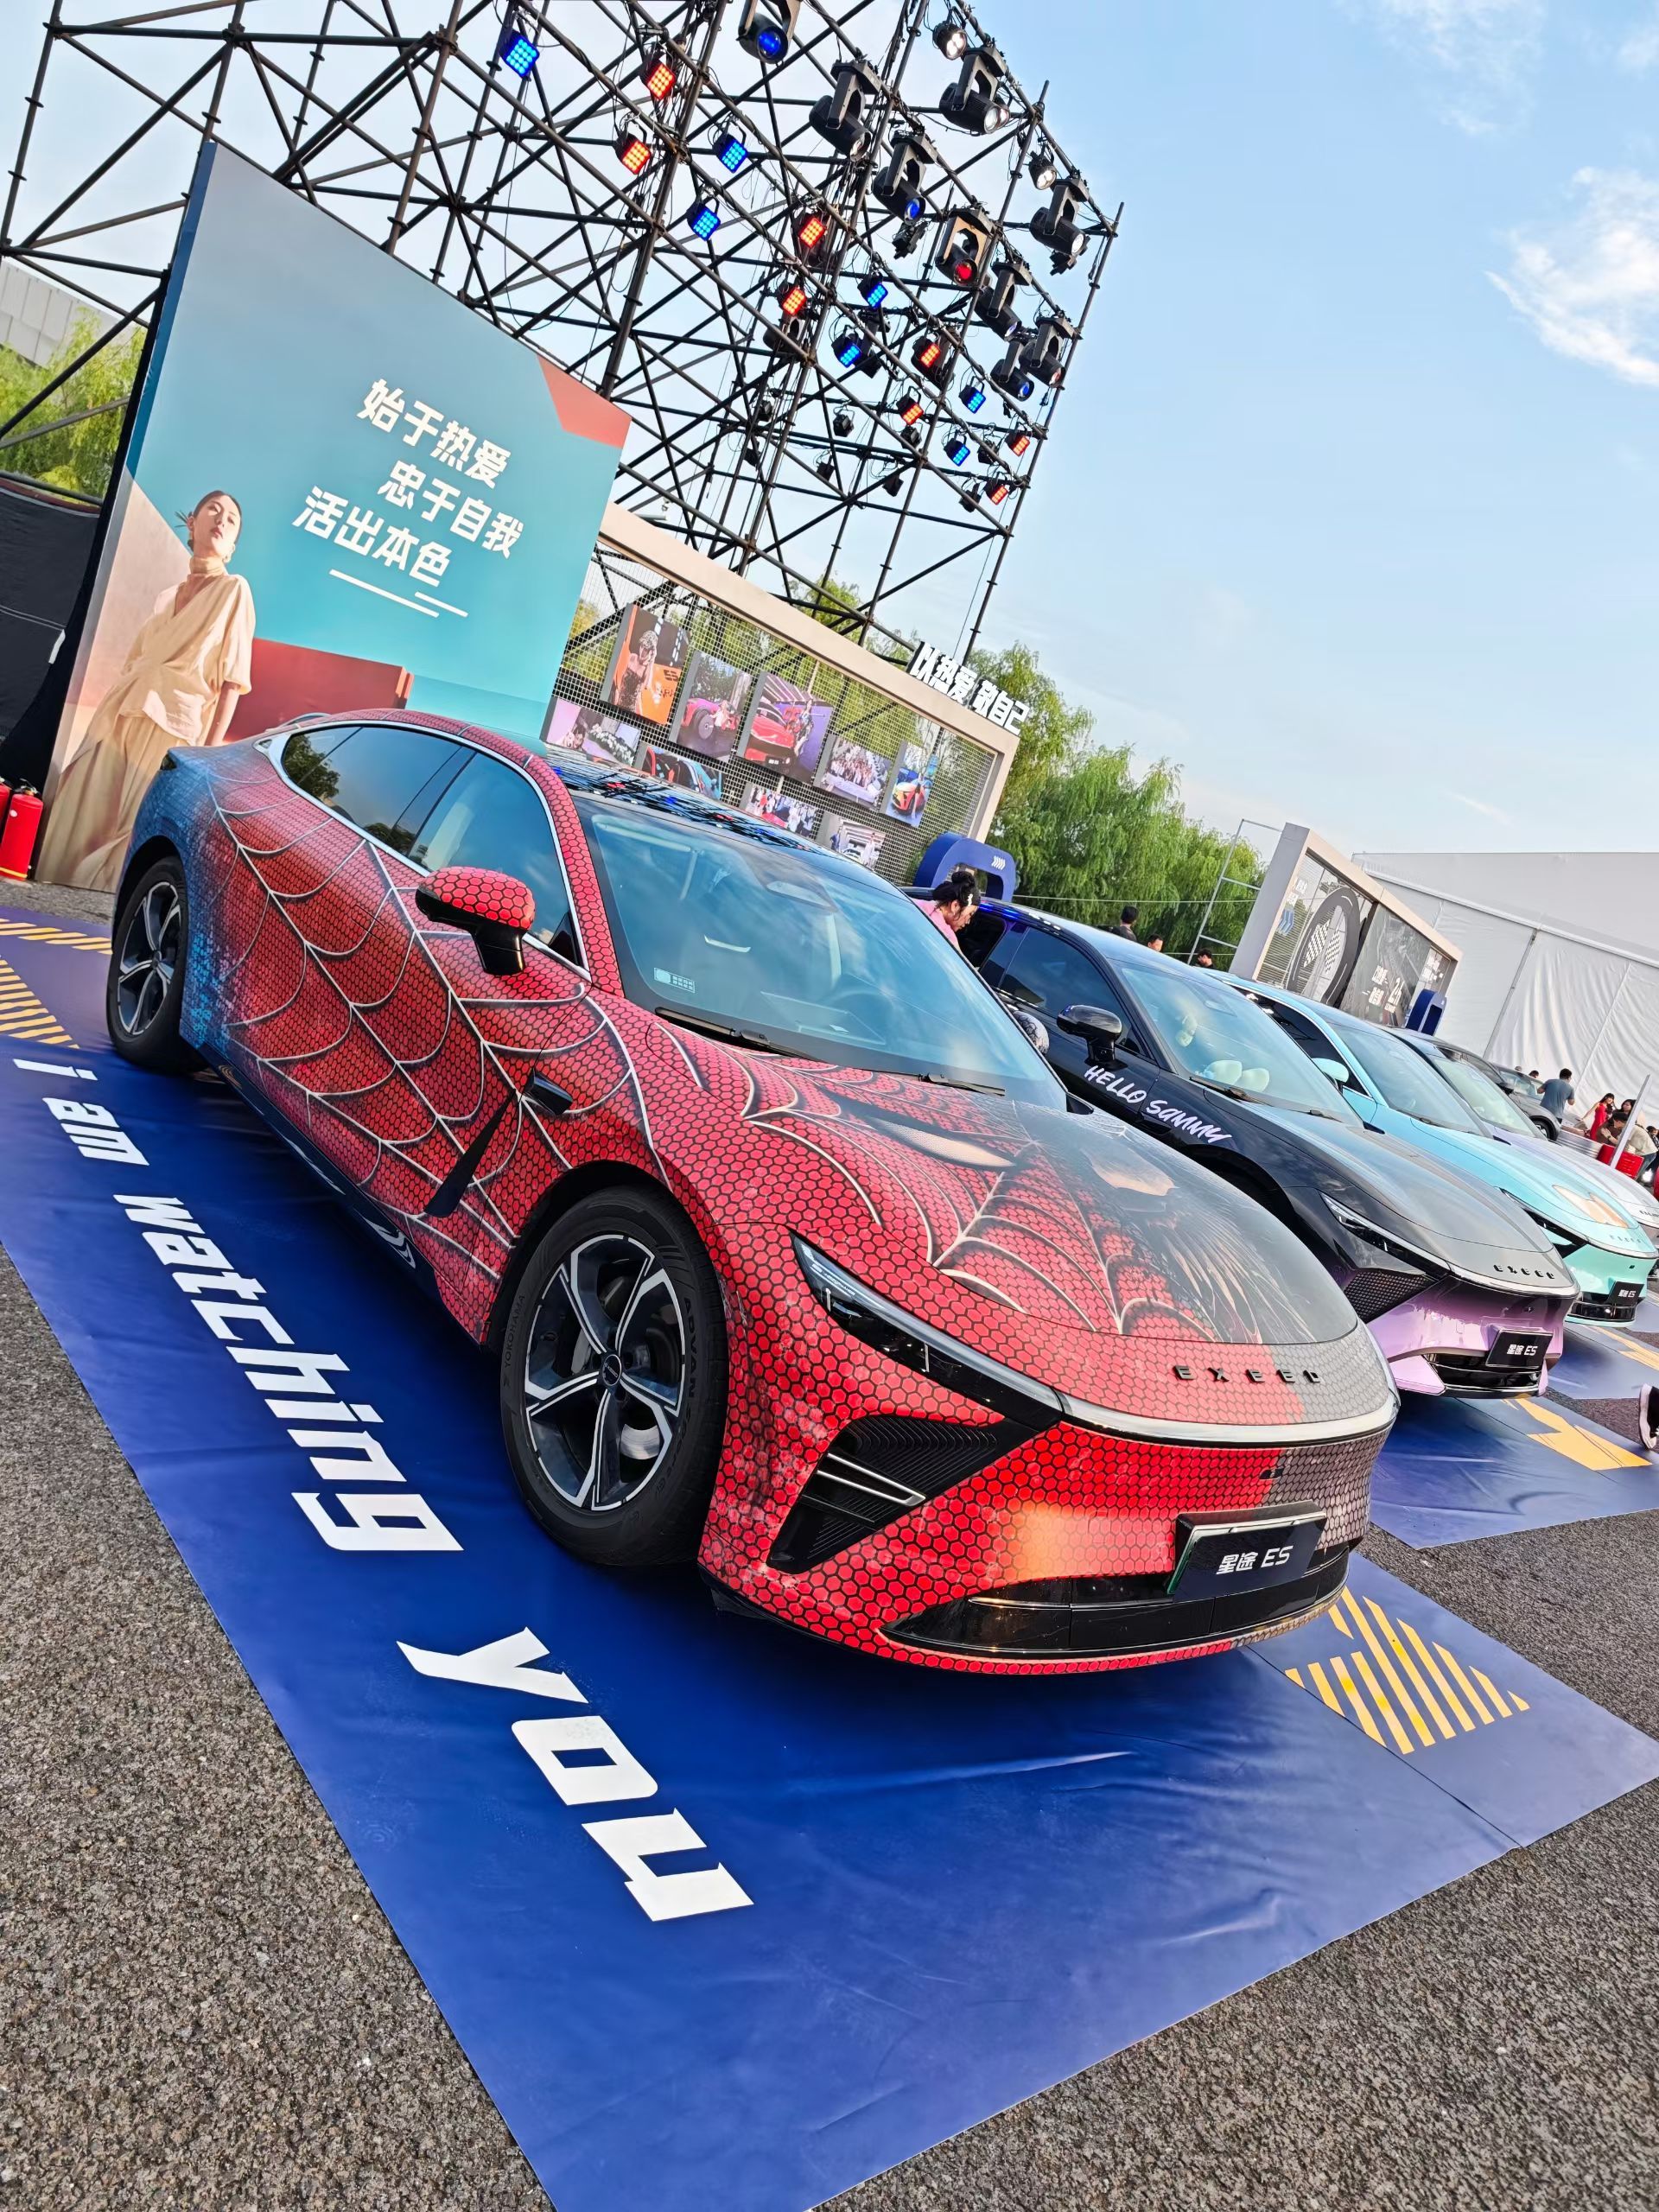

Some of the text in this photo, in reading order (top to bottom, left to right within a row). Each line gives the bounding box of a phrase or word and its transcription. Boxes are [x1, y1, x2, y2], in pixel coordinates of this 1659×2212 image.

[356, 378, 512, 489] 始于热爱
[292, 486, 453, 588] 活出本色
[377, 460, 524, 559] 忠于自我
[908, 641, 1030, 735] 以热爱 敬自己
[1084, 1065, 1147, 1103] HELLO
[505, 1294, 525, 1369] YOKOHAMA
[683, 1297, 698, 1397] ADVAN
[1524, 1345, 1538, 1356] ES
[13, 1058, 754, 1922] i am watching you
[1216, 1545, 1294, 1575] 星途 ES
